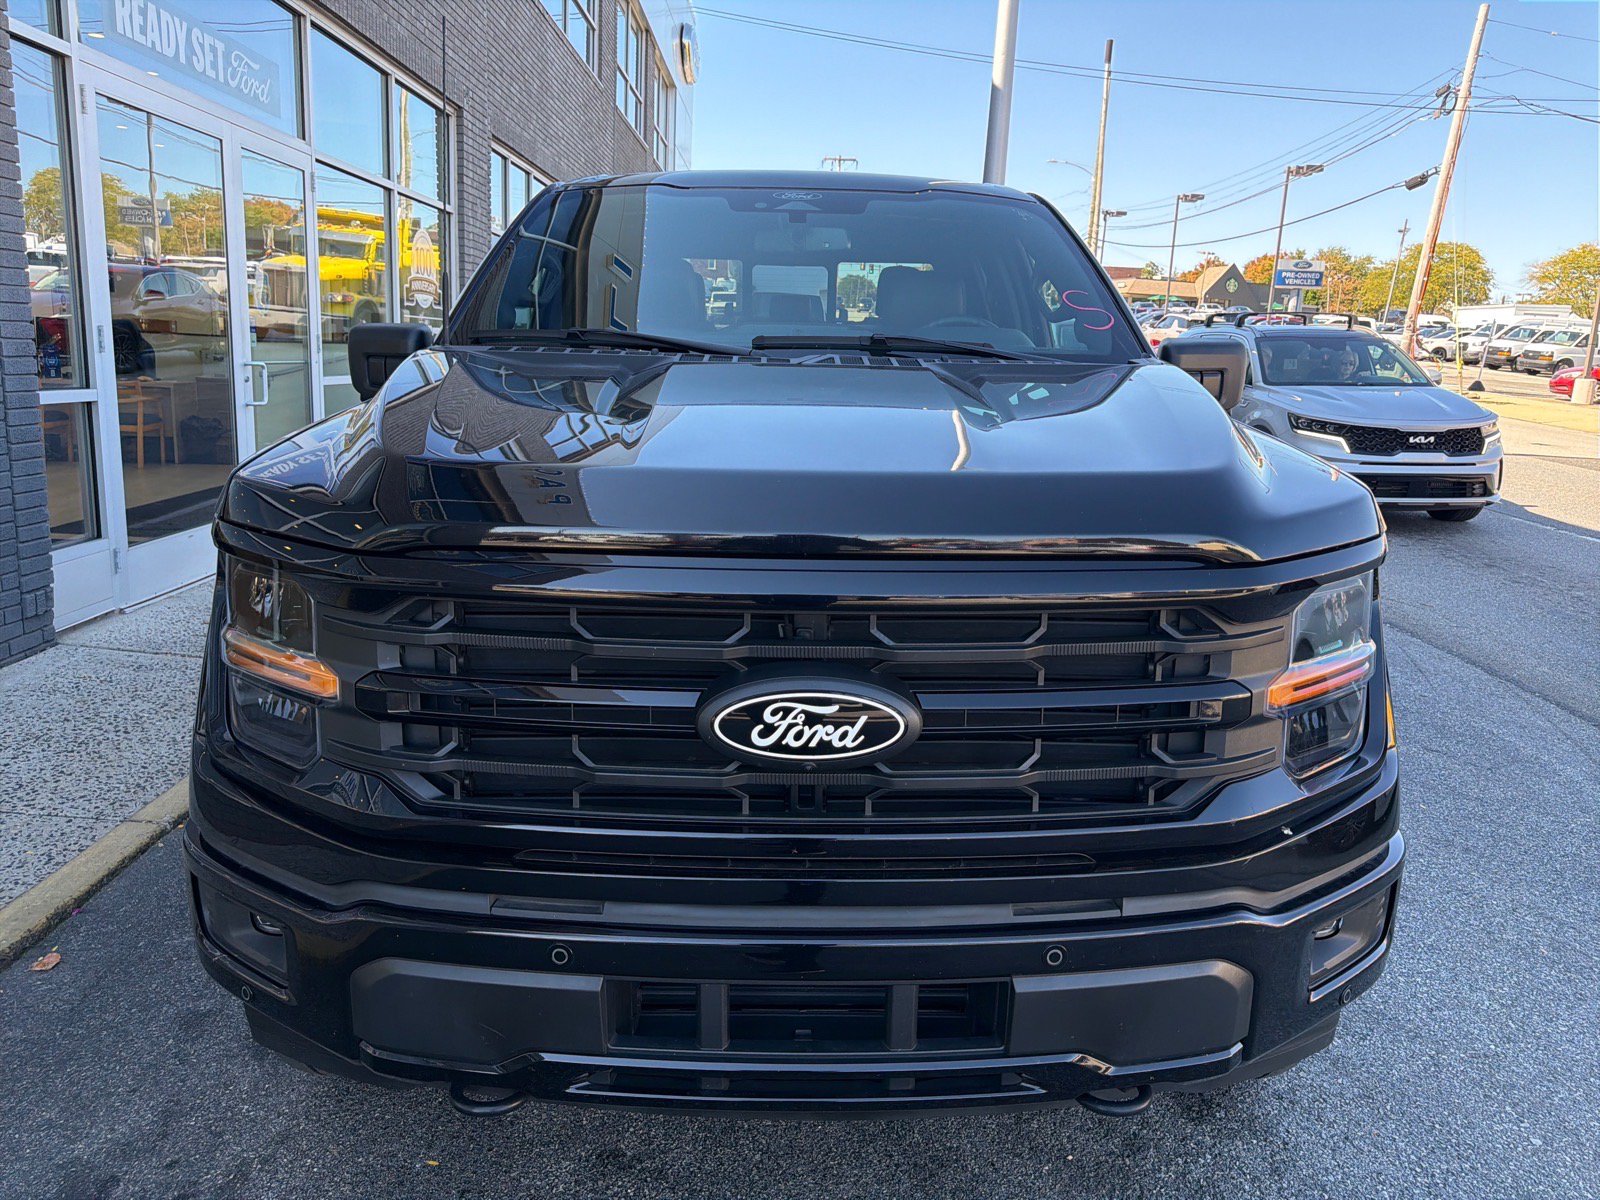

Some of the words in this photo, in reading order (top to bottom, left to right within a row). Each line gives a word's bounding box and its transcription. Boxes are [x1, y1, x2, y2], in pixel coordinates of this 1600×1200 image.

[115, 0, 187, 64] READY
[191, 27, 226, 83] SET
[227, 50, 271, 104] Ford
[415, 248, 432, 276] 100
[1062, 289, 1115, 331] S
[750, 701, 869, 749] Ford
